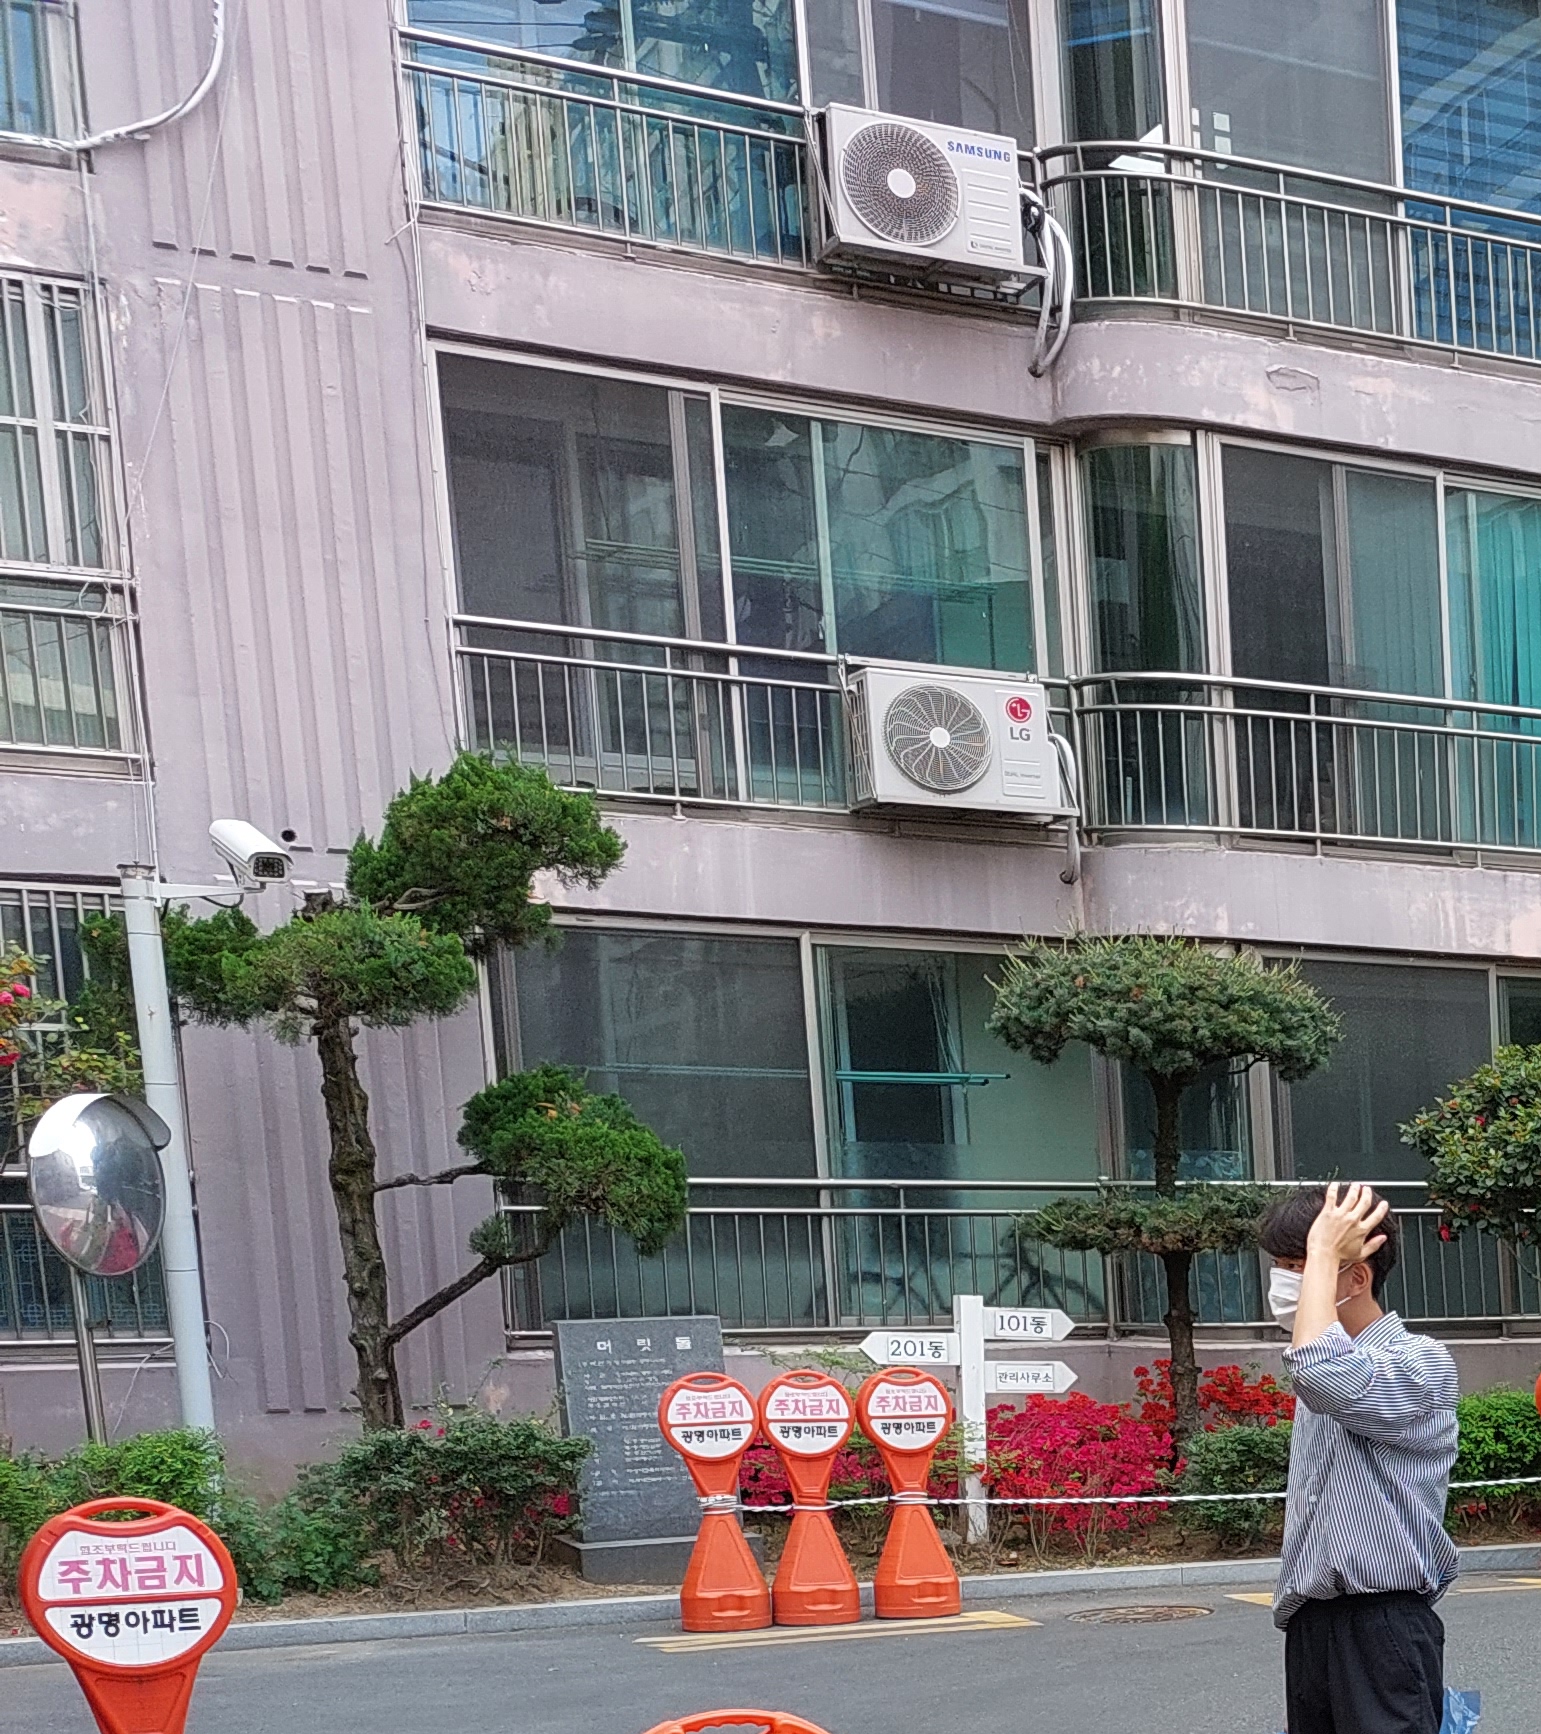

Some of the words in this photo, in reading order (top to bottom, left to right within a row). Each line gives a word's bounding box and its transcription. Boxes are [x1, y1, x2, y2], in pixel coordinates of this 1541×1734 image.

[947, 141, 1011, 163] SAMSUNG
[1009, 726, 1031, 741] LG
[999, 1315, 1048, 1334] 101동
[890, 1340, 946, 1359] 201동
[675, 1399, 744, 1421] 주차금지
[774, 1398, 841, 1416] 주차금지
[875, 1394, 939, 1413] 주차금지
[681, 1427, 744, 1444] 광명아파트
[779, 1425, 839, 1439] 광명아파트
[880, 1421, 937, 1435] 광명아파트
[57, 1553, 205, 1595] 주차금지
[69, 1607, 202, 1640] 광명아파트
